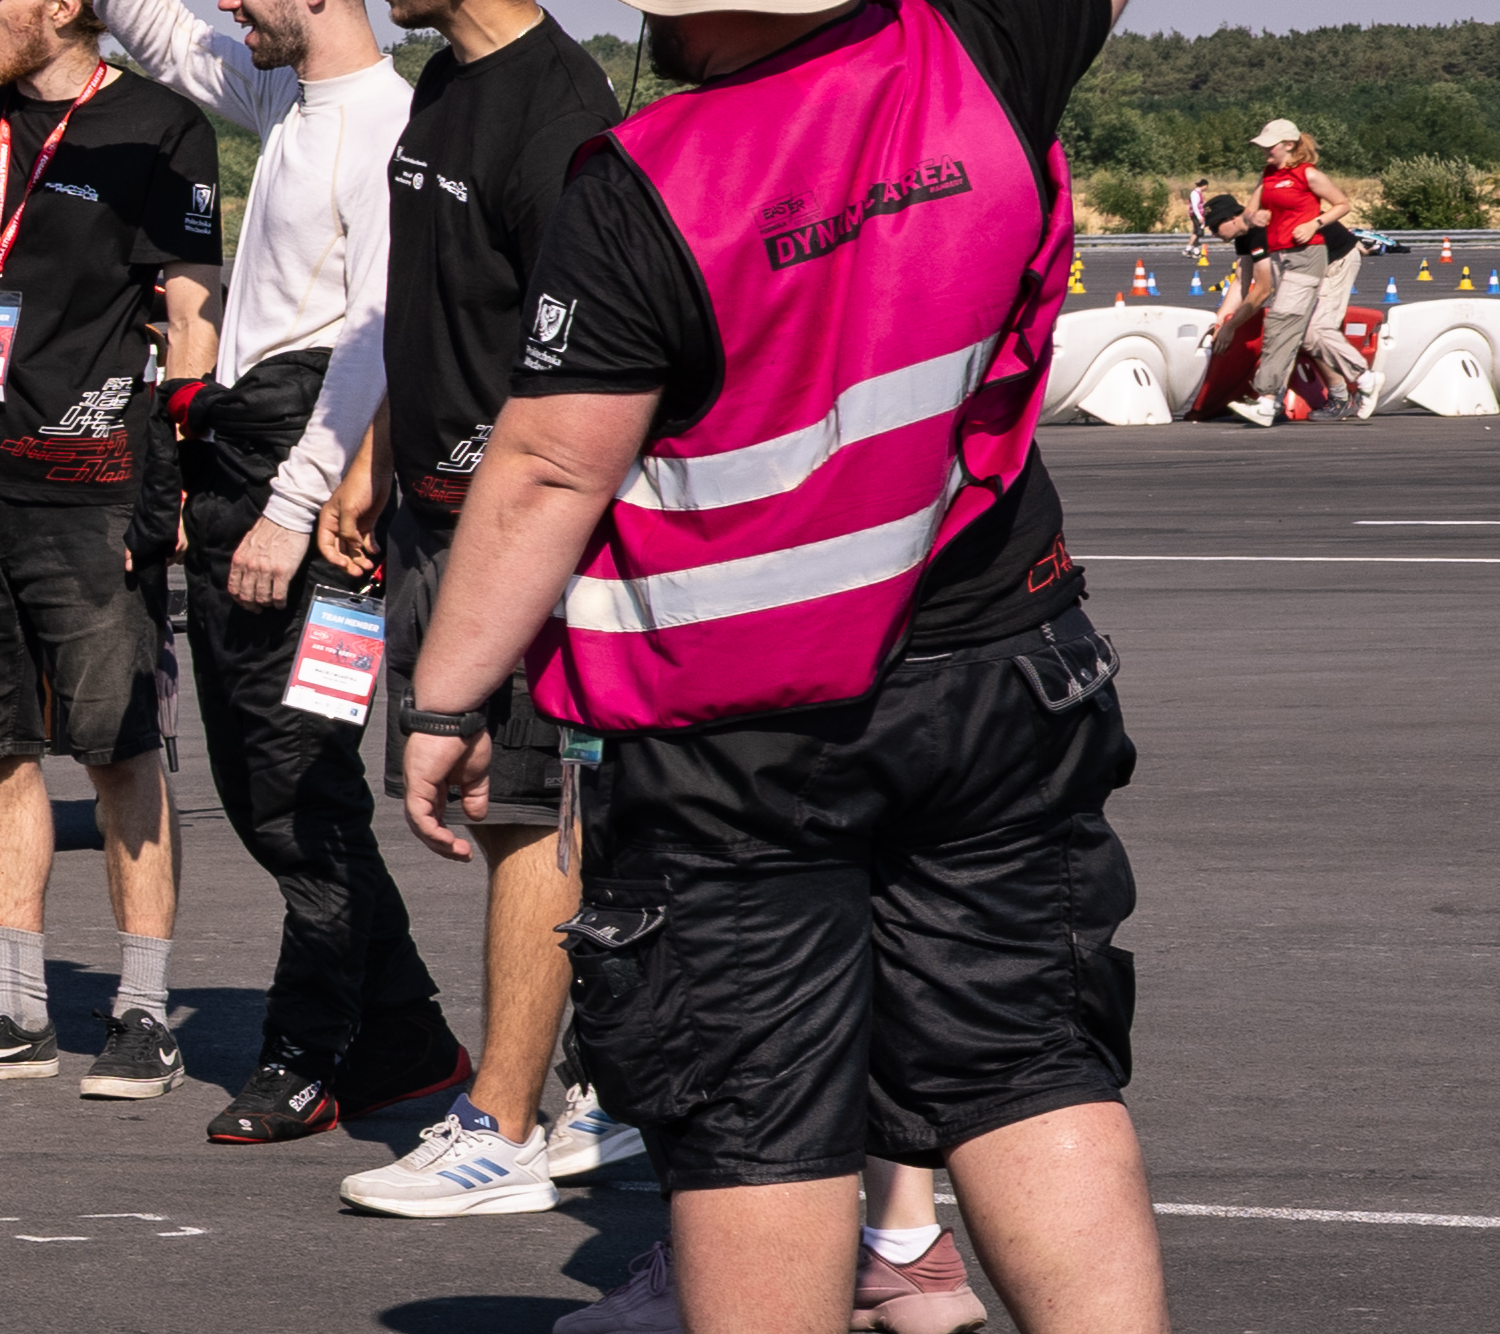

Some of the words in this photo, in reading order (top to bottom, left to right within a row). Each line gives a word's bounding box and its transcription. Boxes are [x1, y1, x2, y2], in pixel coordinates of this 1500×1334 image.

[884, 153, 962, 203] AREA
[321, 611, 344, 624] TEAM
[344, 616, 380, 633] MEMBER
